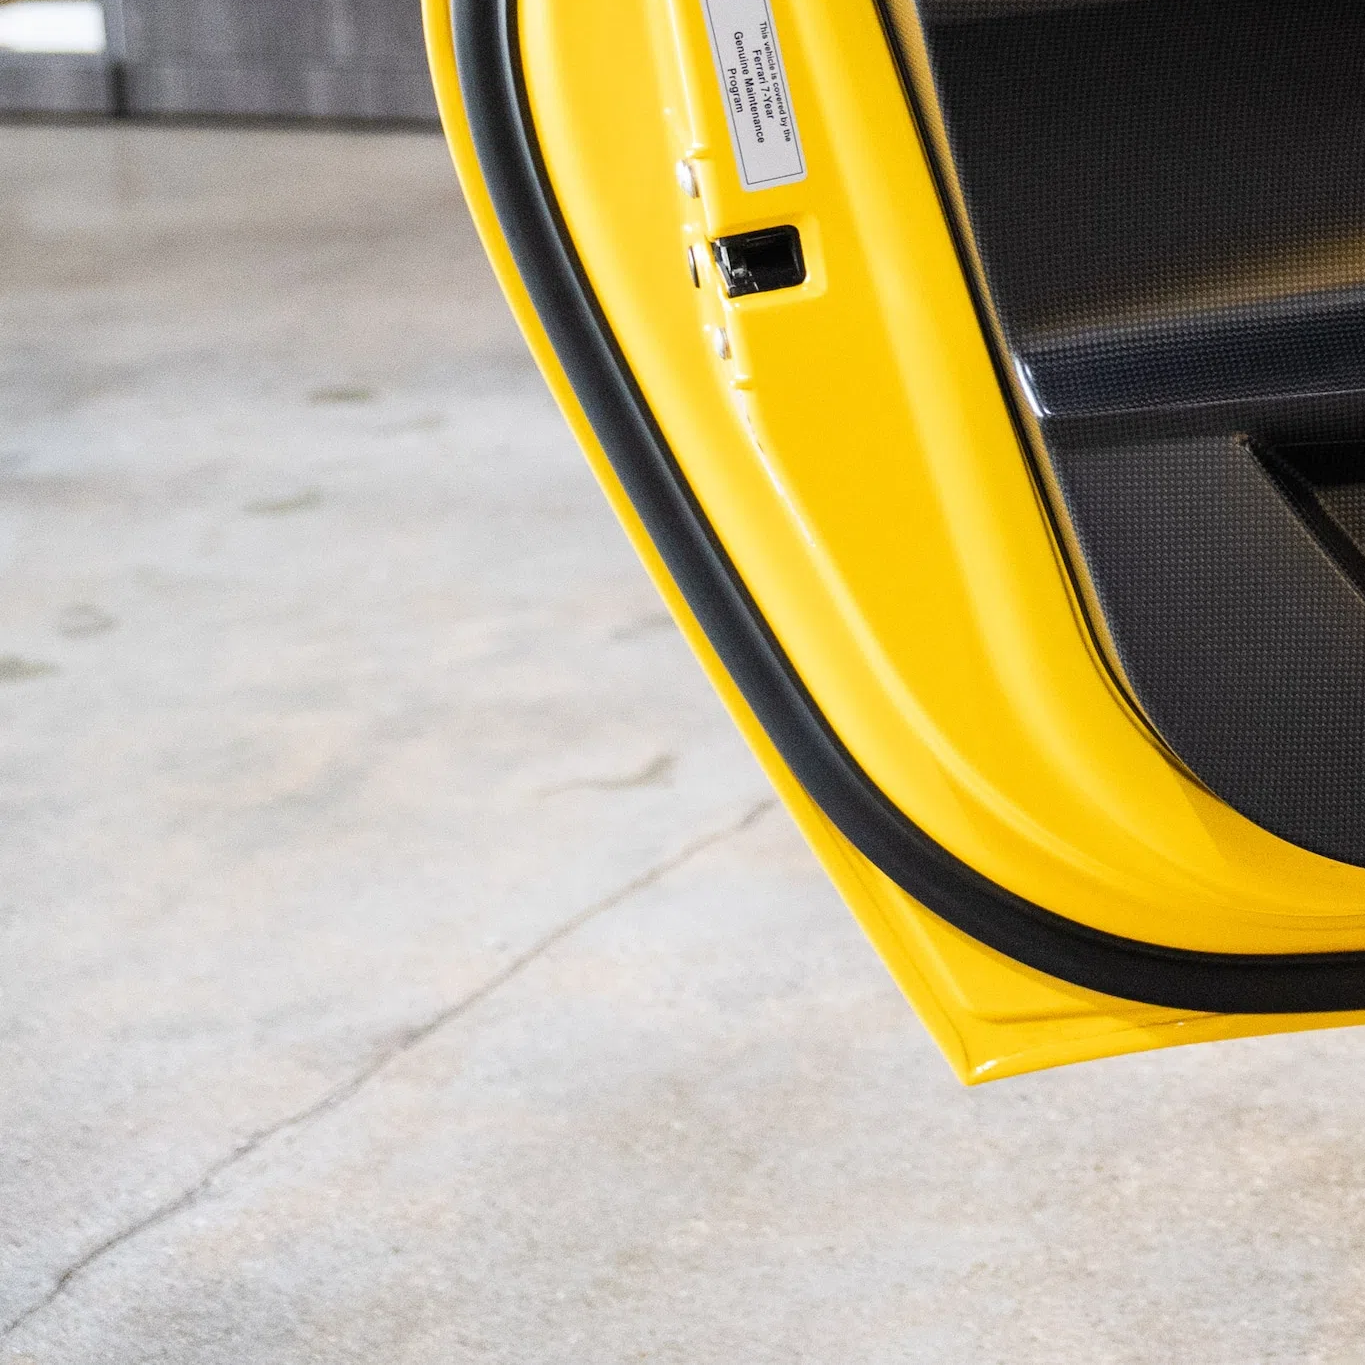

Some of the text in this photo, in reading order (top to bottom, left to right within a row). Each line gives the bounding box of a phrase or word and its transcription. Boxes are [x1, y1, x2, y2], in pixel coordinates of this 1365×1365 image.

[727, 67, 744, 113] Program
[734, 31, 765, 143] Genuine Maintenance
[752, 49, 774, 119] Ferrari 7-Year
[759, 21, 792, 142] This vehicle is covered by the
